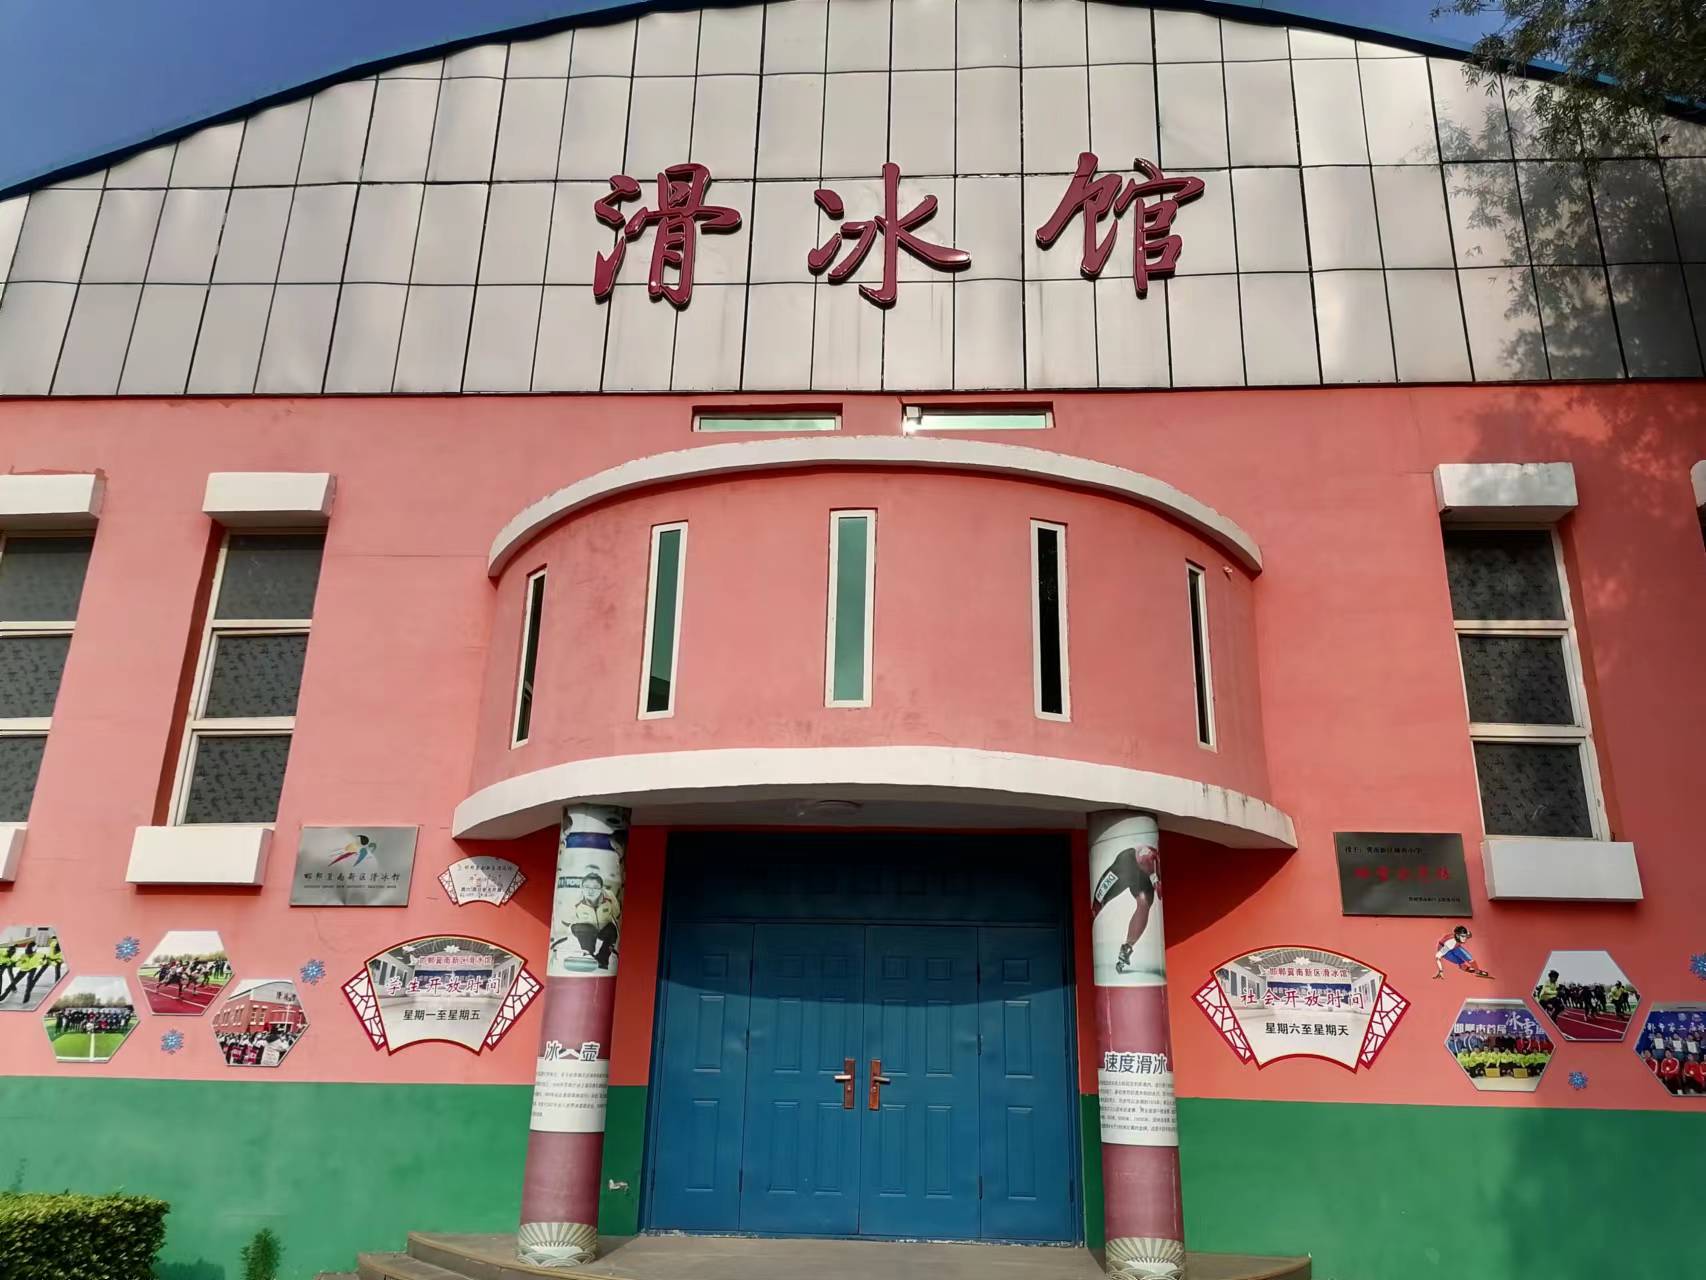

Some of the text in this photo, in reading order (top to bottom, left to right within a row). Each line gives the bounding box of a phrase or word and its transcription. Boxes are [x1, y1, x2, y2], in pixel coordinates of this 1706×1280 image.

[593, 151, 1206, 311] 滑冰馆
[386, 976, 501, 996] 学生开放时间
[1240, 989, 1365, 1009] 社会开放时间
[403, 1009, 480, 1021] 星期一至星期五
[1265, 1022, 1350, 1036] 星期六至星期天
[1105, 1053, 1167, 1074] 速度滑冰
